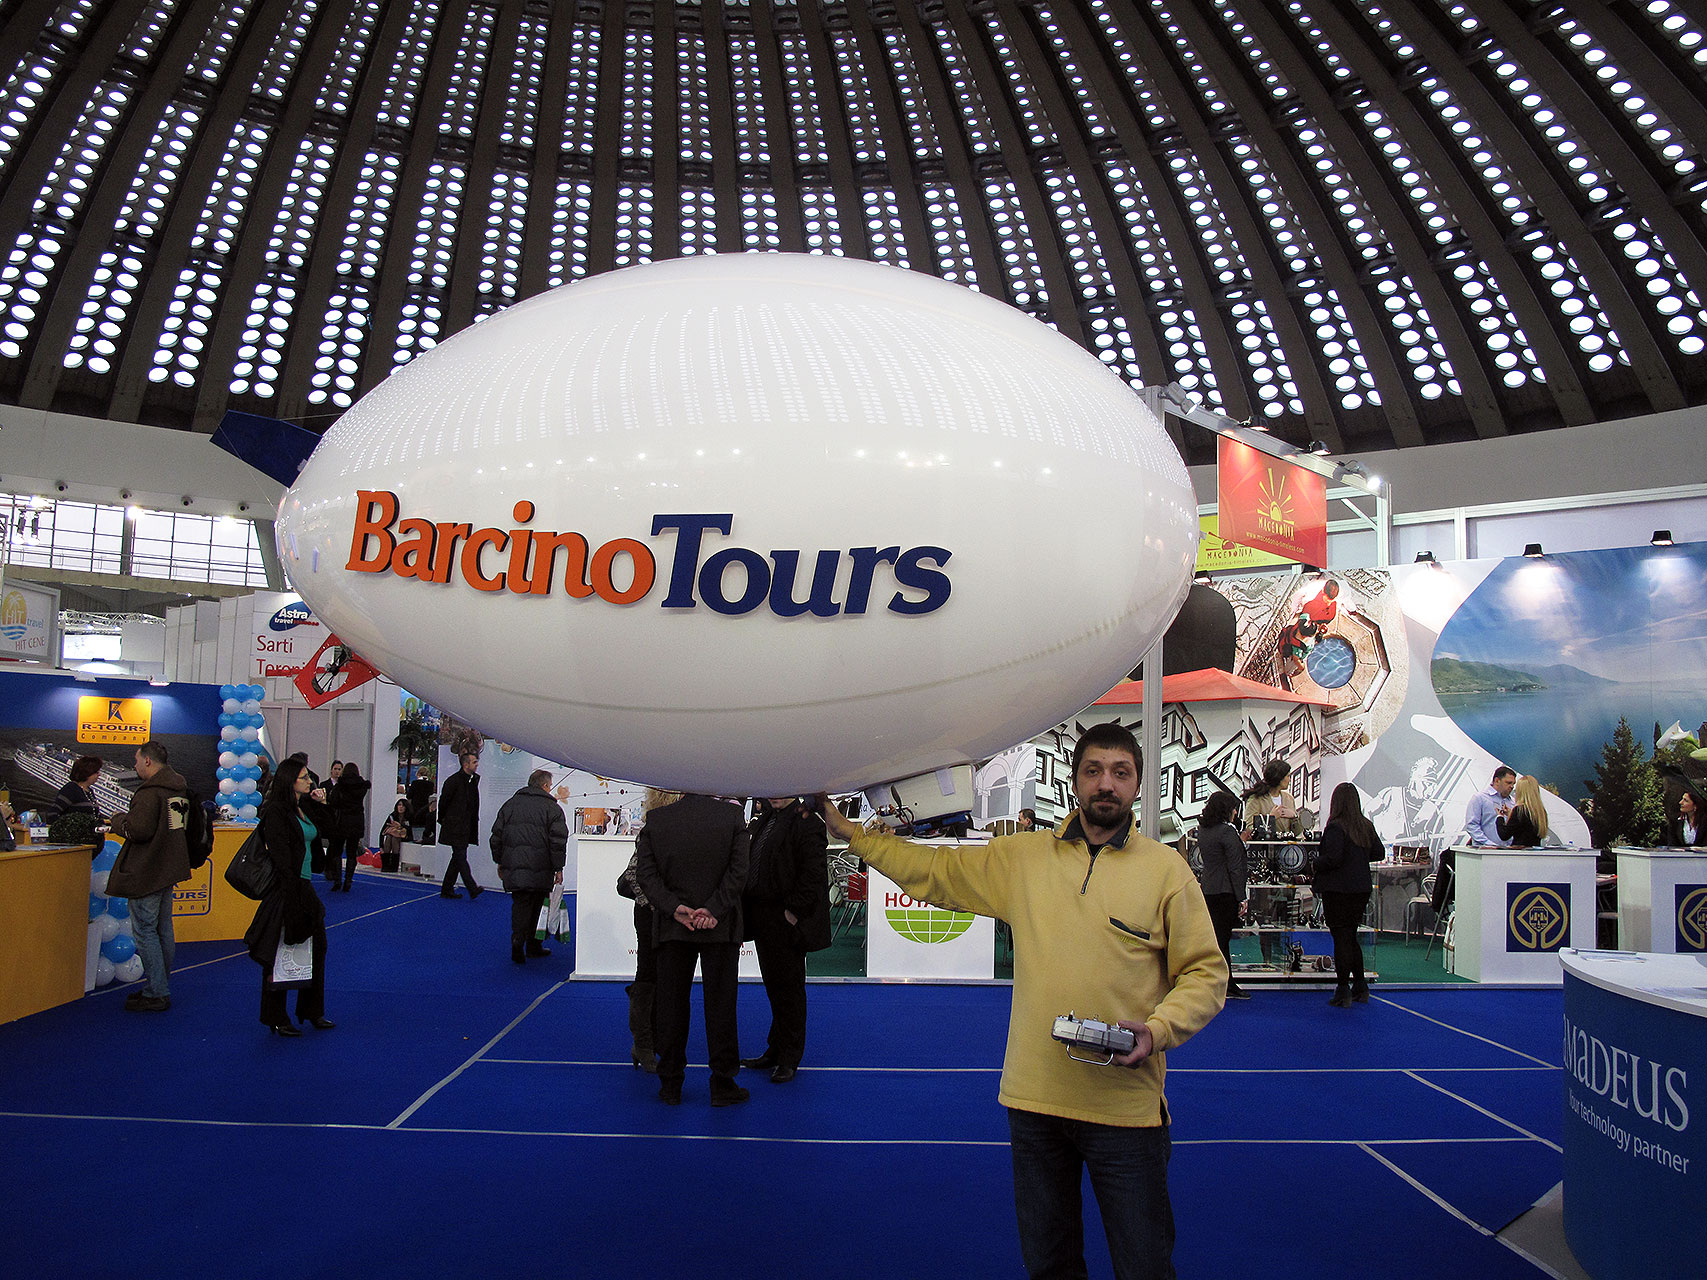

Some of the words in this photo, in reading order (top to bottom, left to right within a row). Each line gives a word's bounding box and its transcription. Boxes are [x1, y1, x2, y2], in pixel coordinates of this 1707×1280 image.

[1258, 516, 1295, 541] MACEDONIA
[345, 489, 656, 605] Barcino
[650, 513, 953, 617] Tours
[1207, 548, 1253, 559] MACEDONIA
[278, 608, 309, 619] Astra
[15, 639, 27, 651] HIT
[256, 635, 293, 653] Sarti
[82, 723, 147, 732] R-TOURS
[1580, 1101, 1631, 1153] technology
[1633, 1135, 1690, 1174] partner
